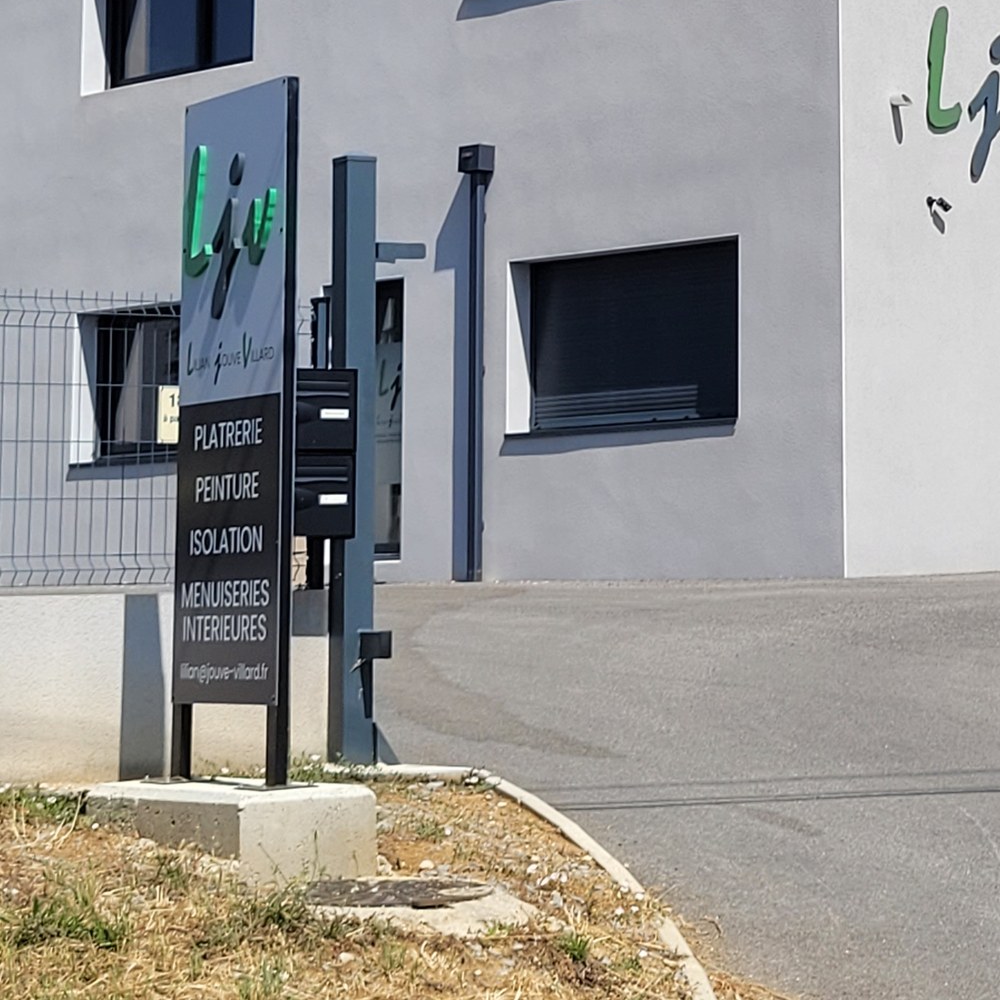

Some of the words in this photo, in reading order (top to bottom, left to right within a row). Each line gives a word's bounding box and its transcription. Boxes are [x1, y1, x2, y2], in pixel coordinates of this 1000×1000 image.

[194, 418, 263, 451] PLATRERIE
[195, 472, 259, 502] PEINTURE
[189, 525, 263, 556] ISOLATION
[181, 579, 270, 608] MENUISERIES
[182, 613, 267, 642] INTERIEURES
